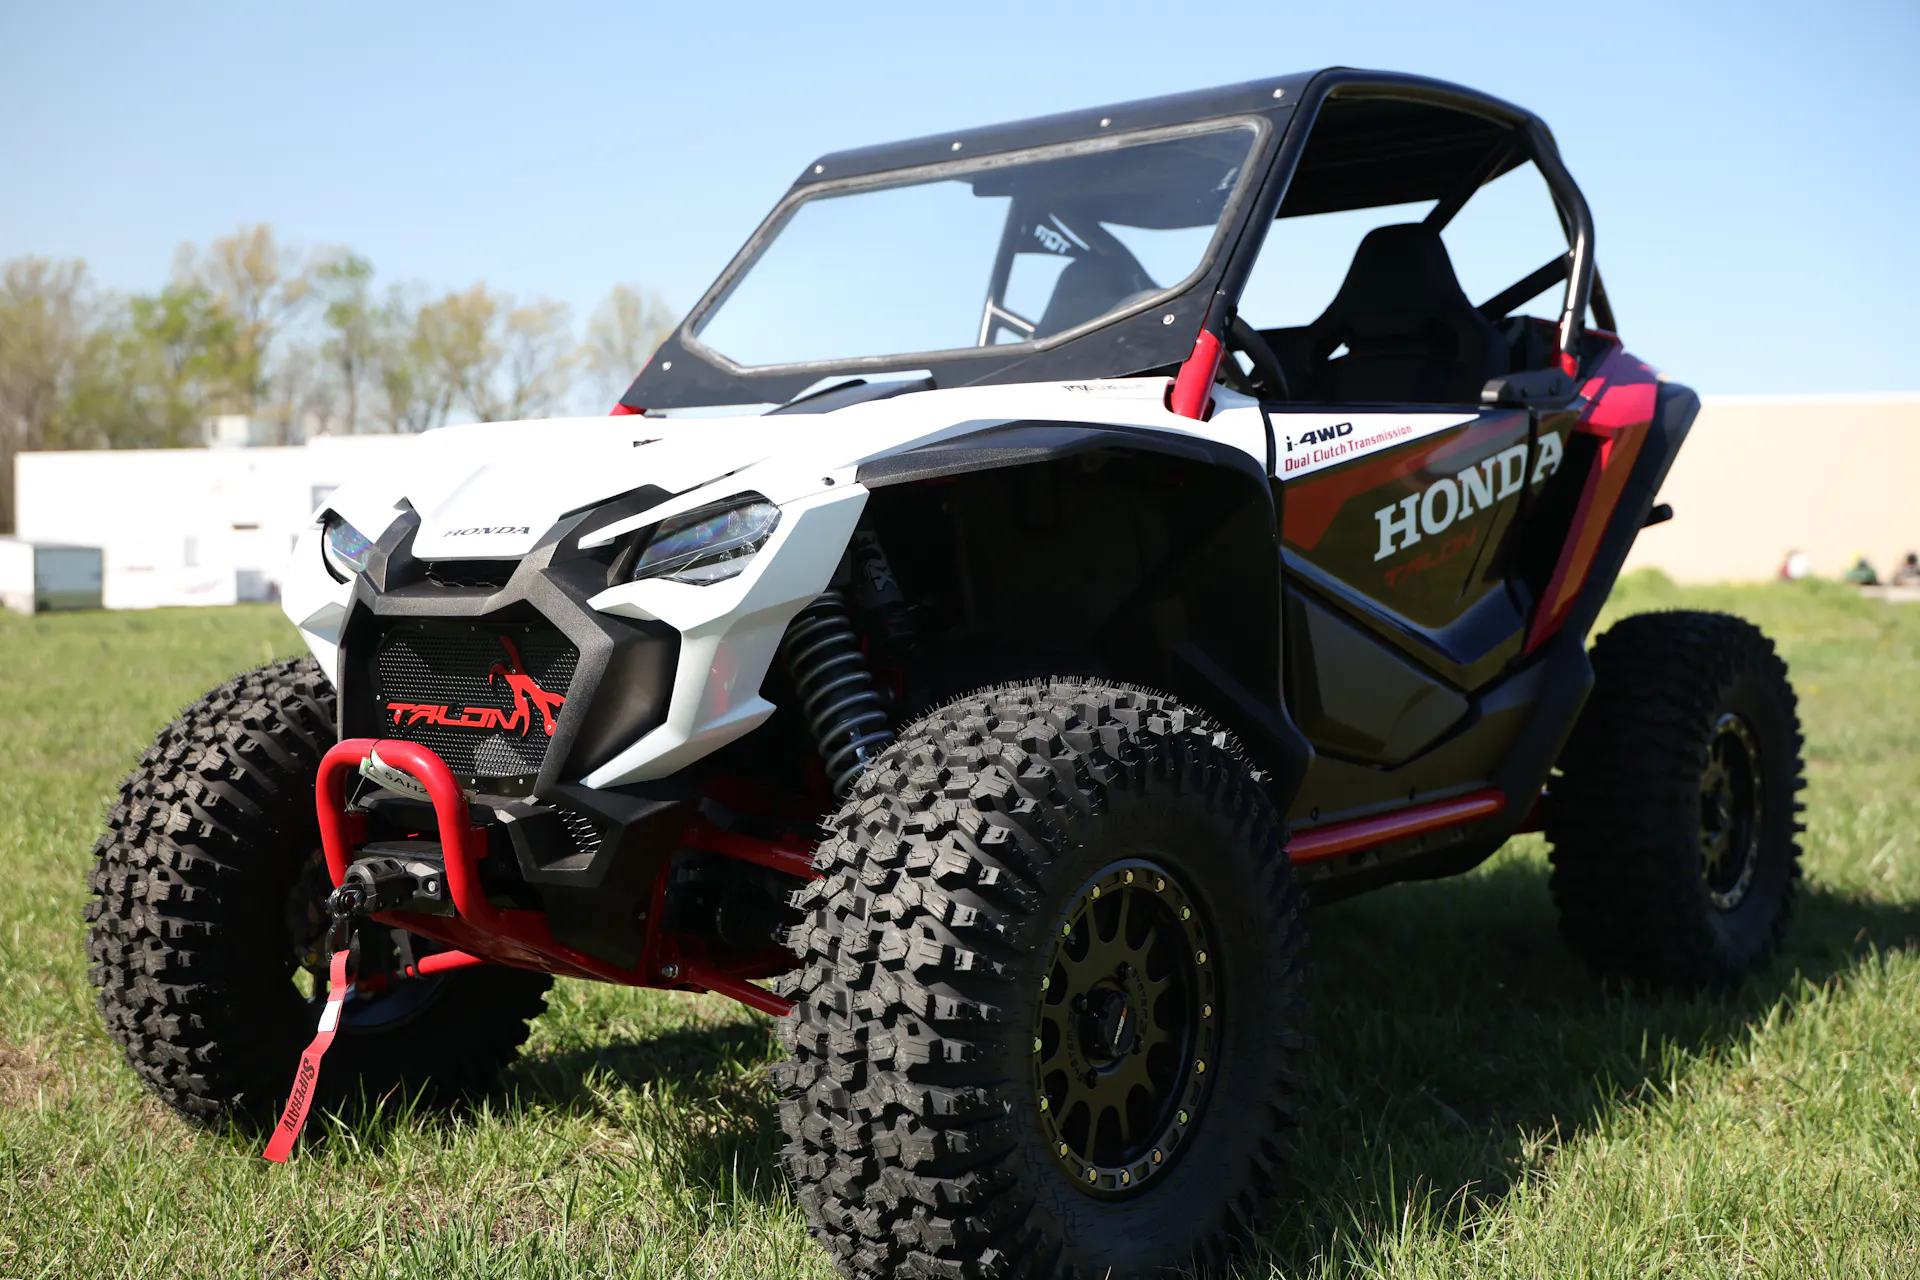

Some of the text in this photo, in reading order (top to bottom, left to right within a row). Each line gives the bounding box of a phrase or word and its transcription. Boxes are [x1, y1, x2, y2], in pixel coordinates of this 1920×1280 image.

[1285, 425, 1412, 472] Dual Clutch Transmission
[1286, 422, 1353, 452] i-4WD
[1373, 431, 1564, 562] HONDA
[441, 526, 530, 538] HONDA
[1383, 526, 1478, 589] TALON
[386, 702, 521, 730] TALON
[283, 1057, 315, 1133] SUPERATV
